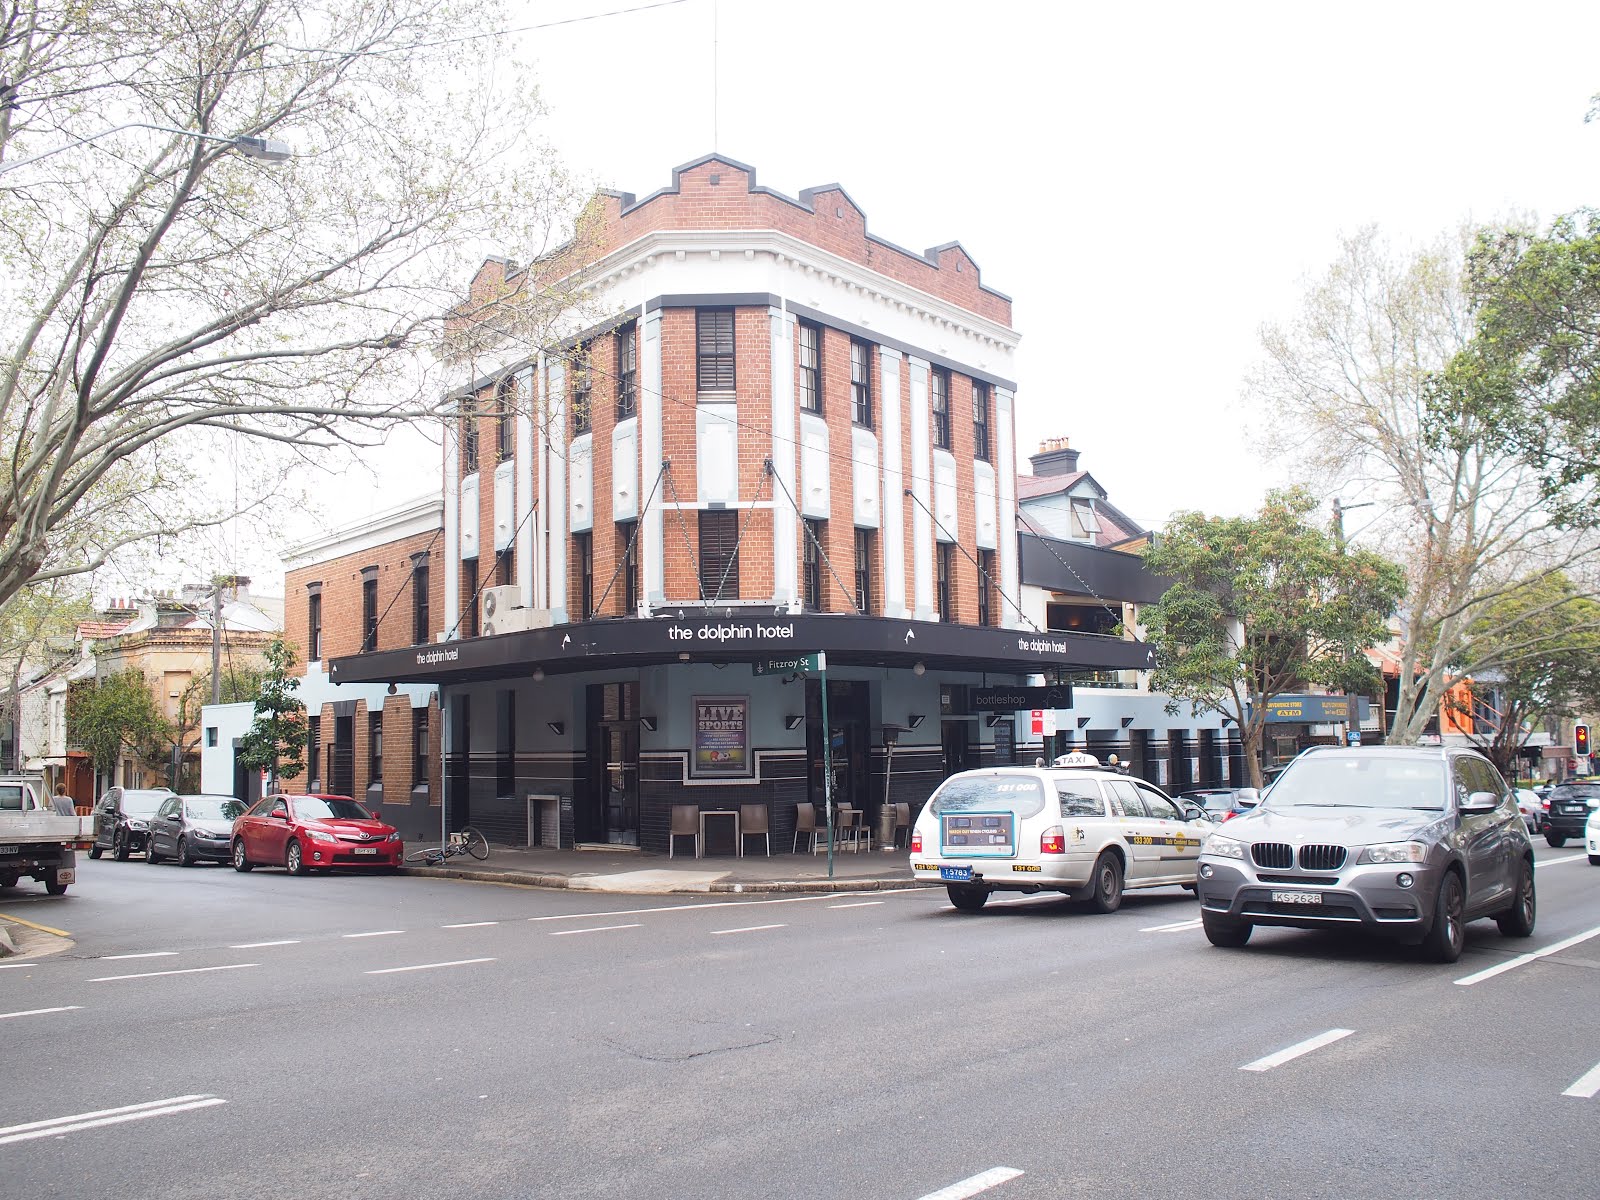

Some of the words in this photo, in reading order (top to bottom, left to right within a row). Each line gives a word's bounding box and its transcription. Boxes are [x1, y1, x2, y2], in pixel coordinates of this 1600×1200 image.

[668, 625, 693, 640] the
[697, 623, 752, 643] dolphin
[756, 623, 794, 638] hotel
[1018, 637, 1029, 650] the
[1029, 638, 1051, 654] dolphin
[1052, 641, 1067, 653] hotel
[416, 652, 425, 664] the
[426, 650, 444, 665] dolphin
[445, 647, 459, 661] hotel
[768, 659, 798, 670] Fitzroy
[800, 657, 809, 666] St
[976, 694, 1026, 706] bottleshop
[698, 706, 744, 720] LIVE
[698, 721, 743, 730] SPORTS
[1062, 756, 1087, 764] TAXI
[997, 784, 1015, 792] 131
[1016, 783, 1038, 791] 008
